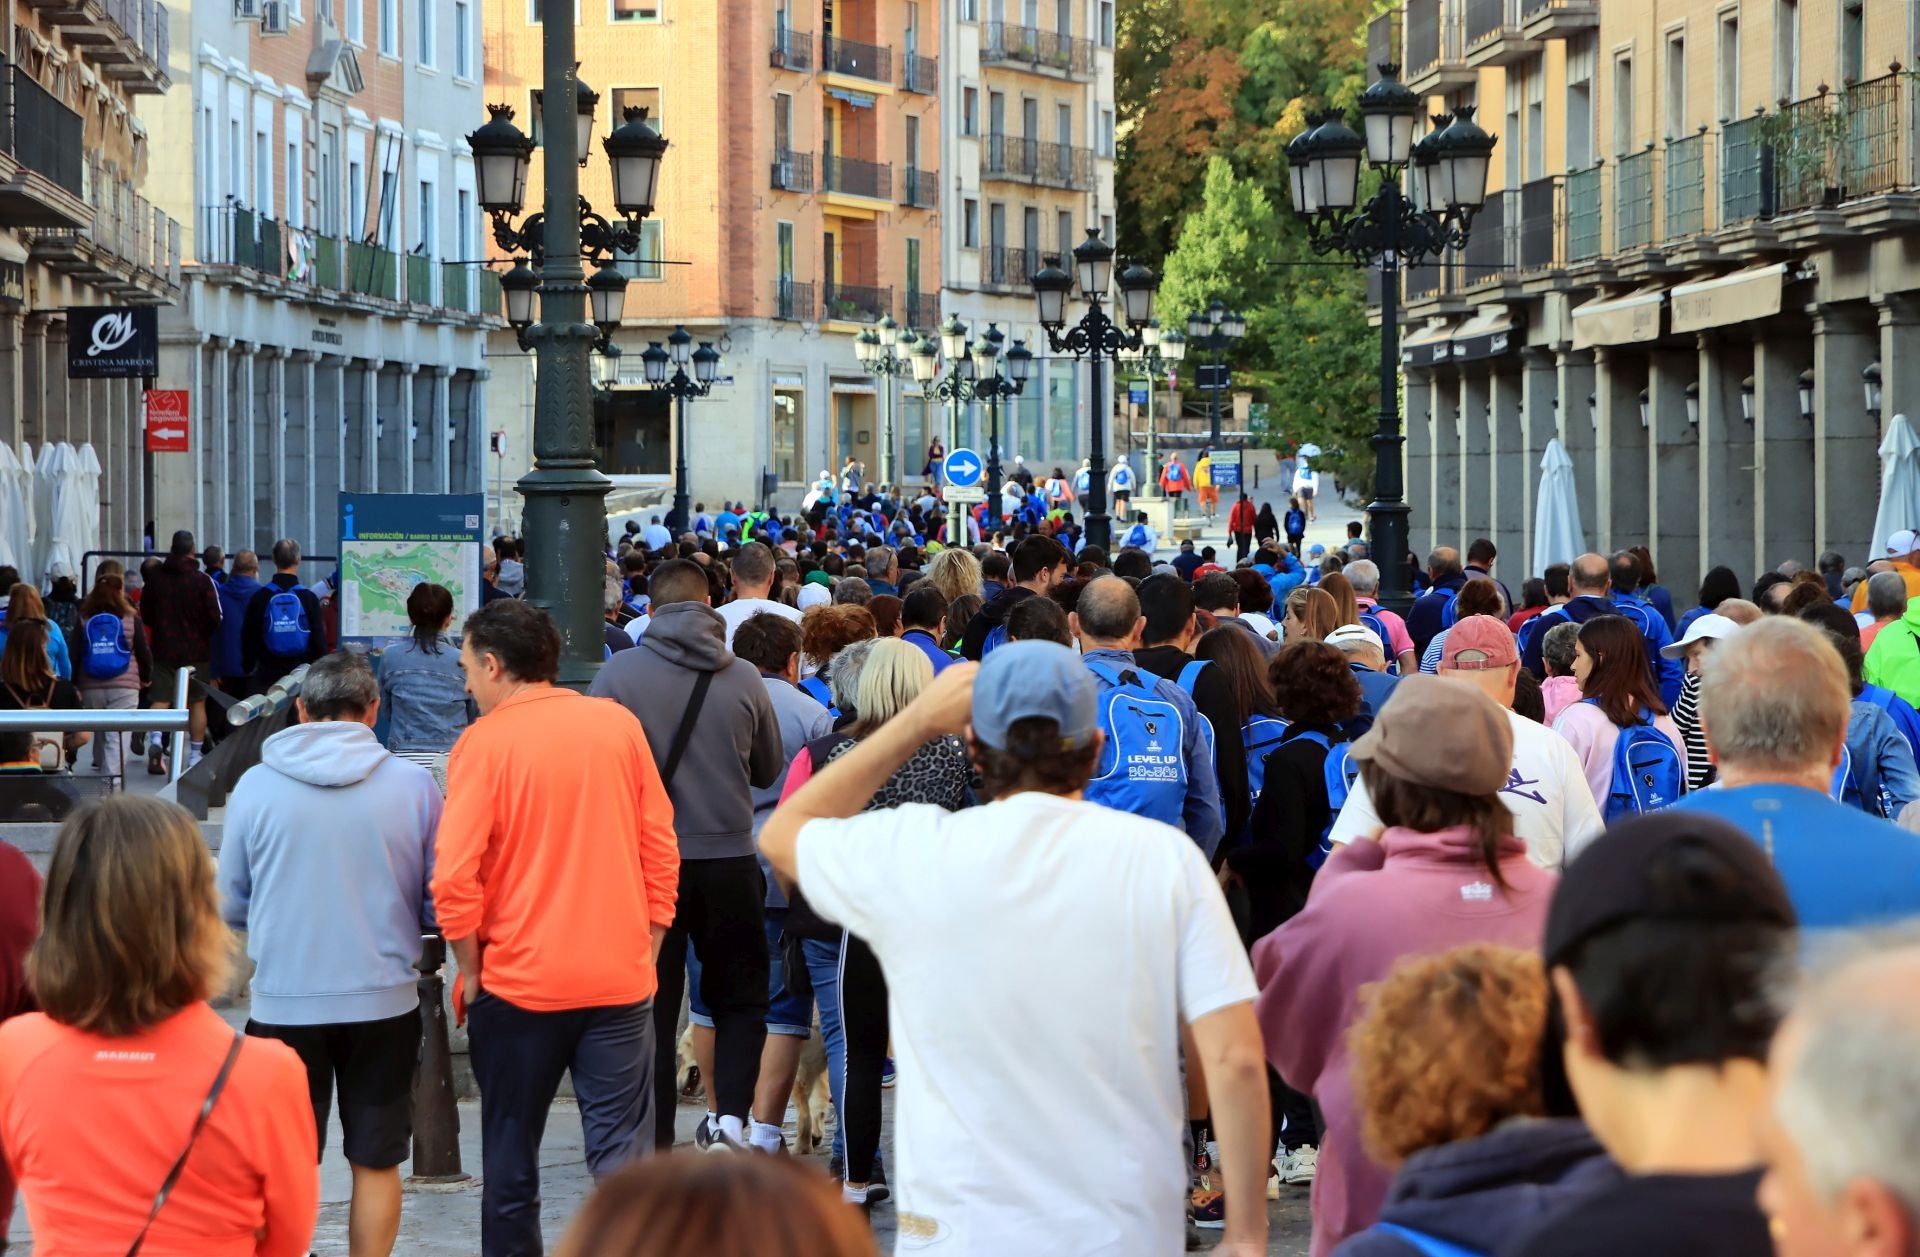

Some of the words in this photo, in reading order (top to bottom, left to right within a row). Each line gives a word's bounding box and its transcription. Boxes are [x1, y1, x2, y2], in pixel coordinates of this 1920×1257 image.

[72, 359, 115, 367] CRISTINA
[116, 359, 153, 367] MARCOS
[358, 532, 404, 540] INFORMACIÓN
[1128, 755, 1163, 764] LEVEL
[1164, 755, 1177, 764] UP
